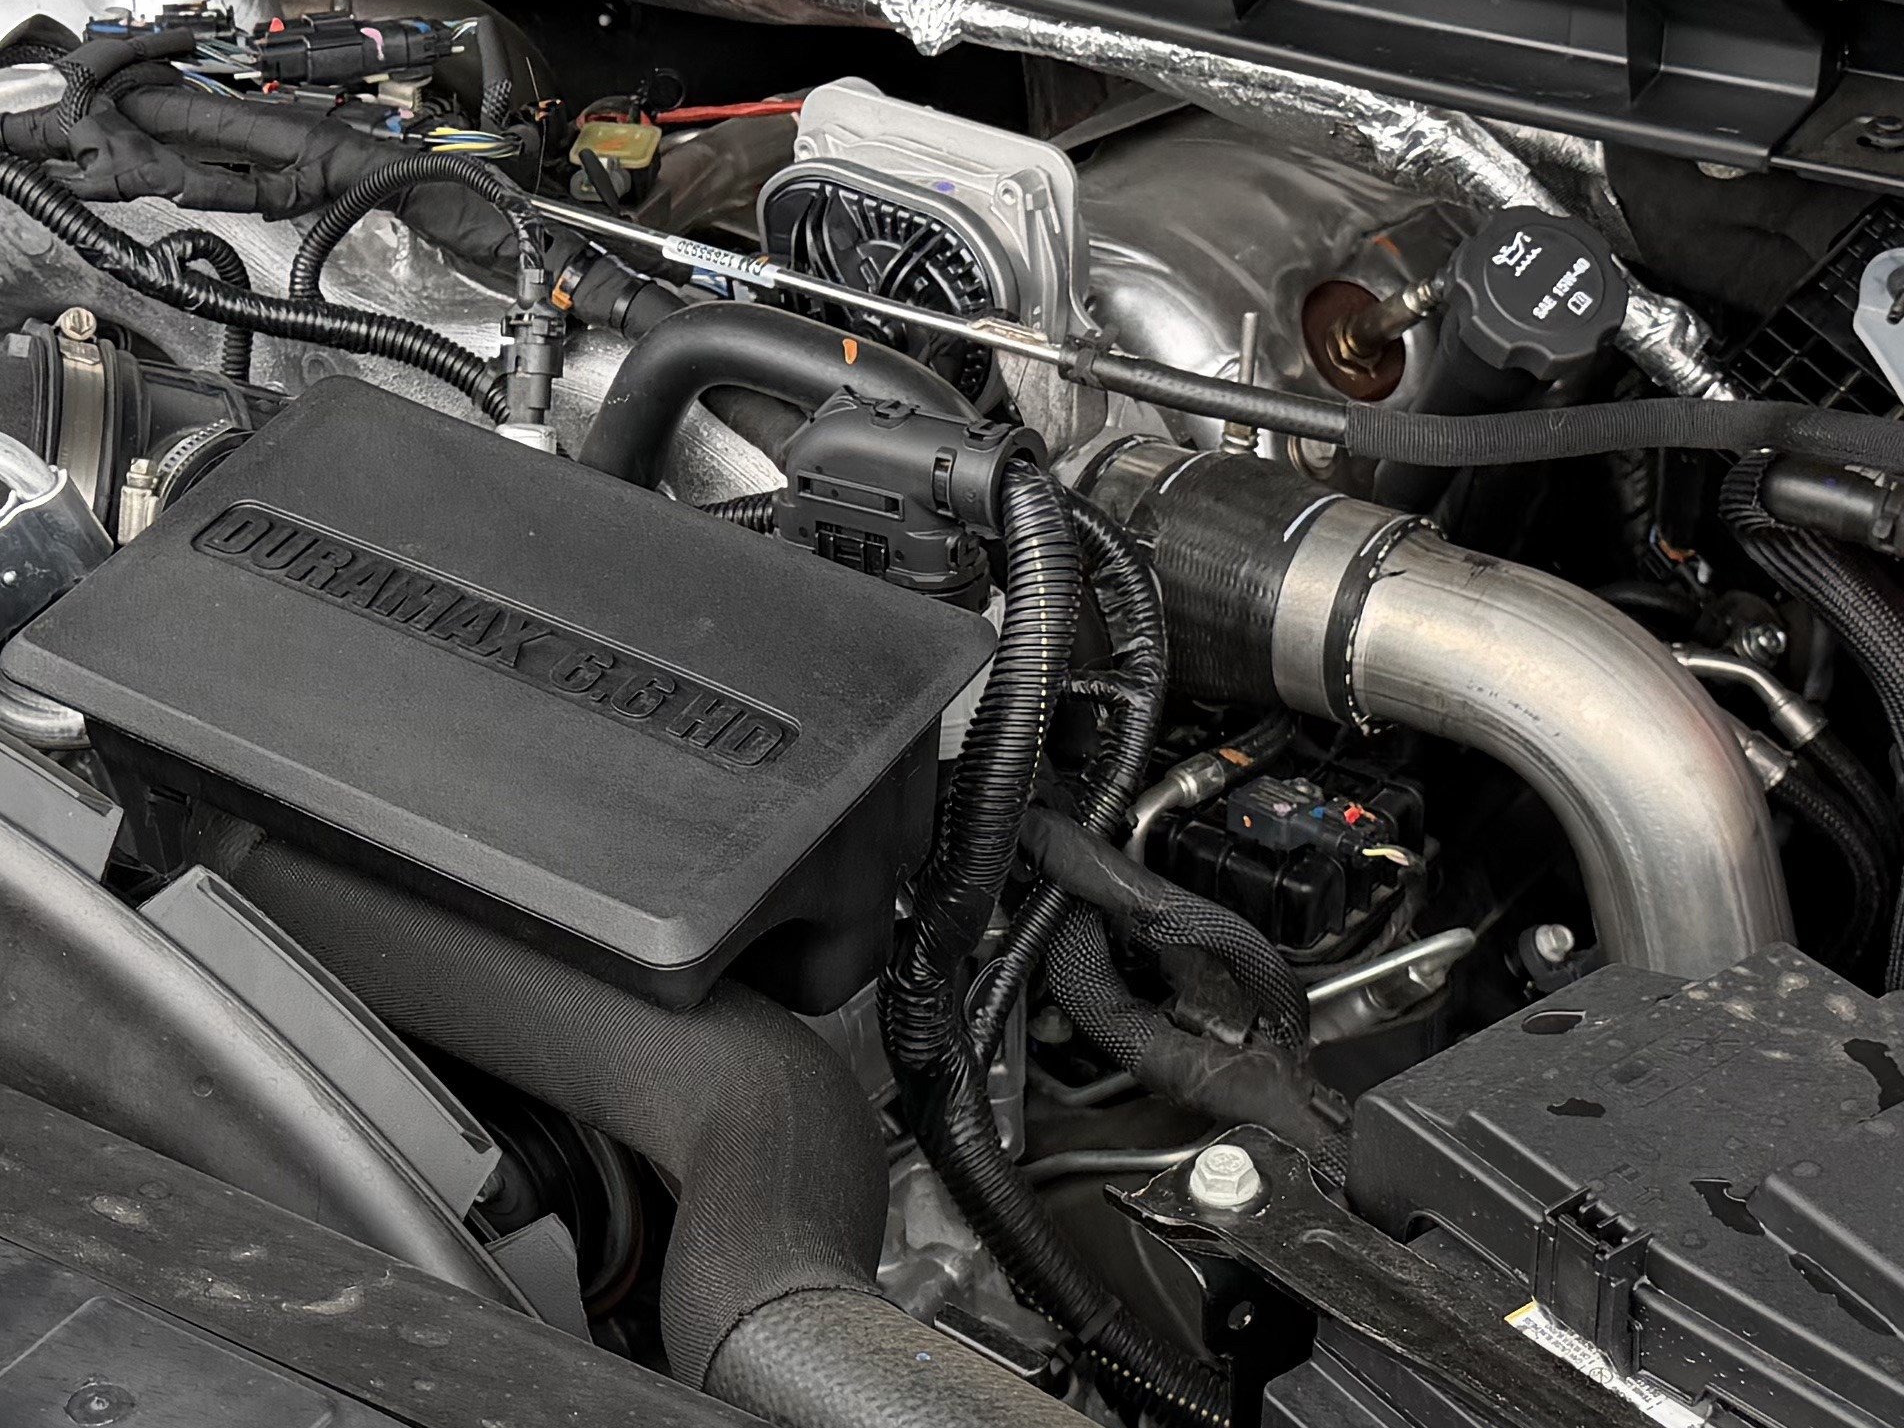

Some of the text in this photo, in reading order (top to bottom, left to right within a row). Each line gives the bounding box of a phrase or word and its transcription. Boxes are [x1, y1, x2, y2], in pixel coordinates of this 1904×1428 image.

[1532, 257, 1591, 320] SAE 15W-40
[202, 510, 790, 767] DURAMAX 6.6 HD
